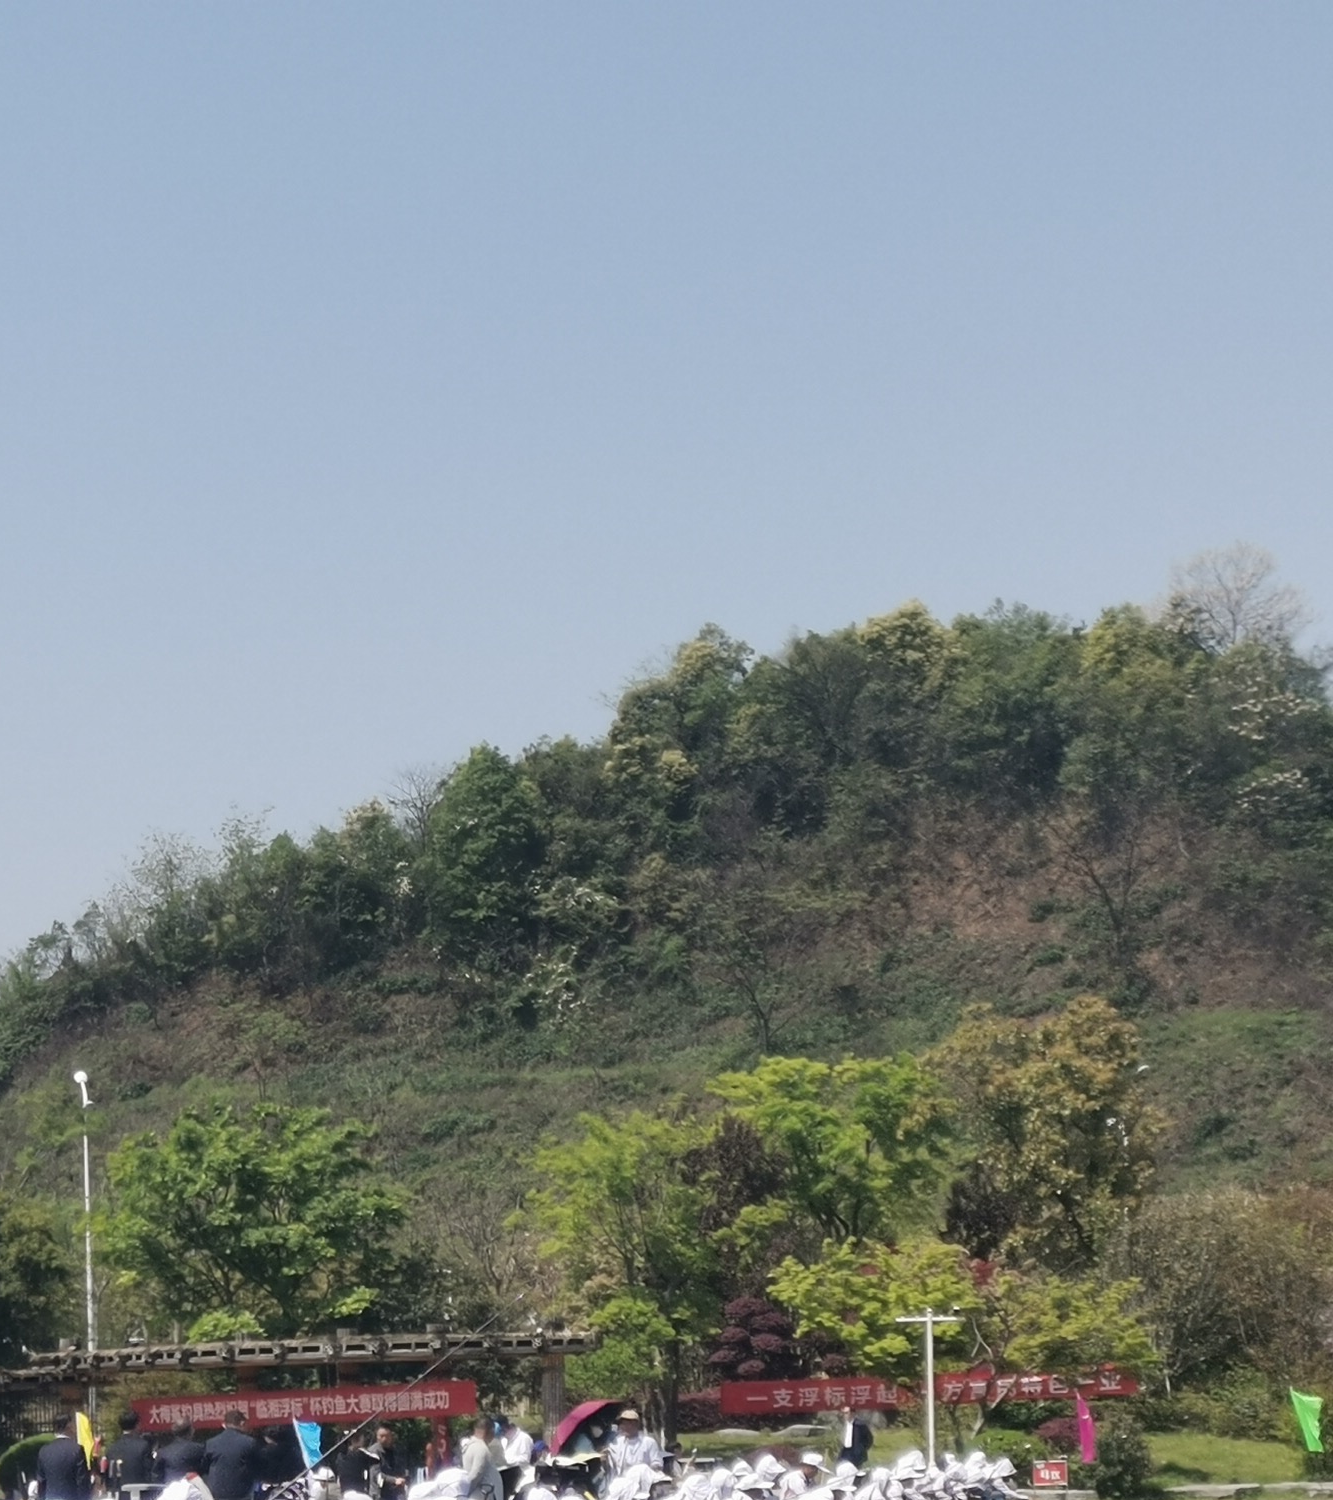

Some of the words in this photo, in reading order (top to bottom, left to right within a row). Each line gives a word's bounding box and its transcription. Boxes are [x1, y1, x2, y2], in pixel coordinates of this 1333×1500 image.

[746, 1383, 898, 1408] 一支浮标浮起
